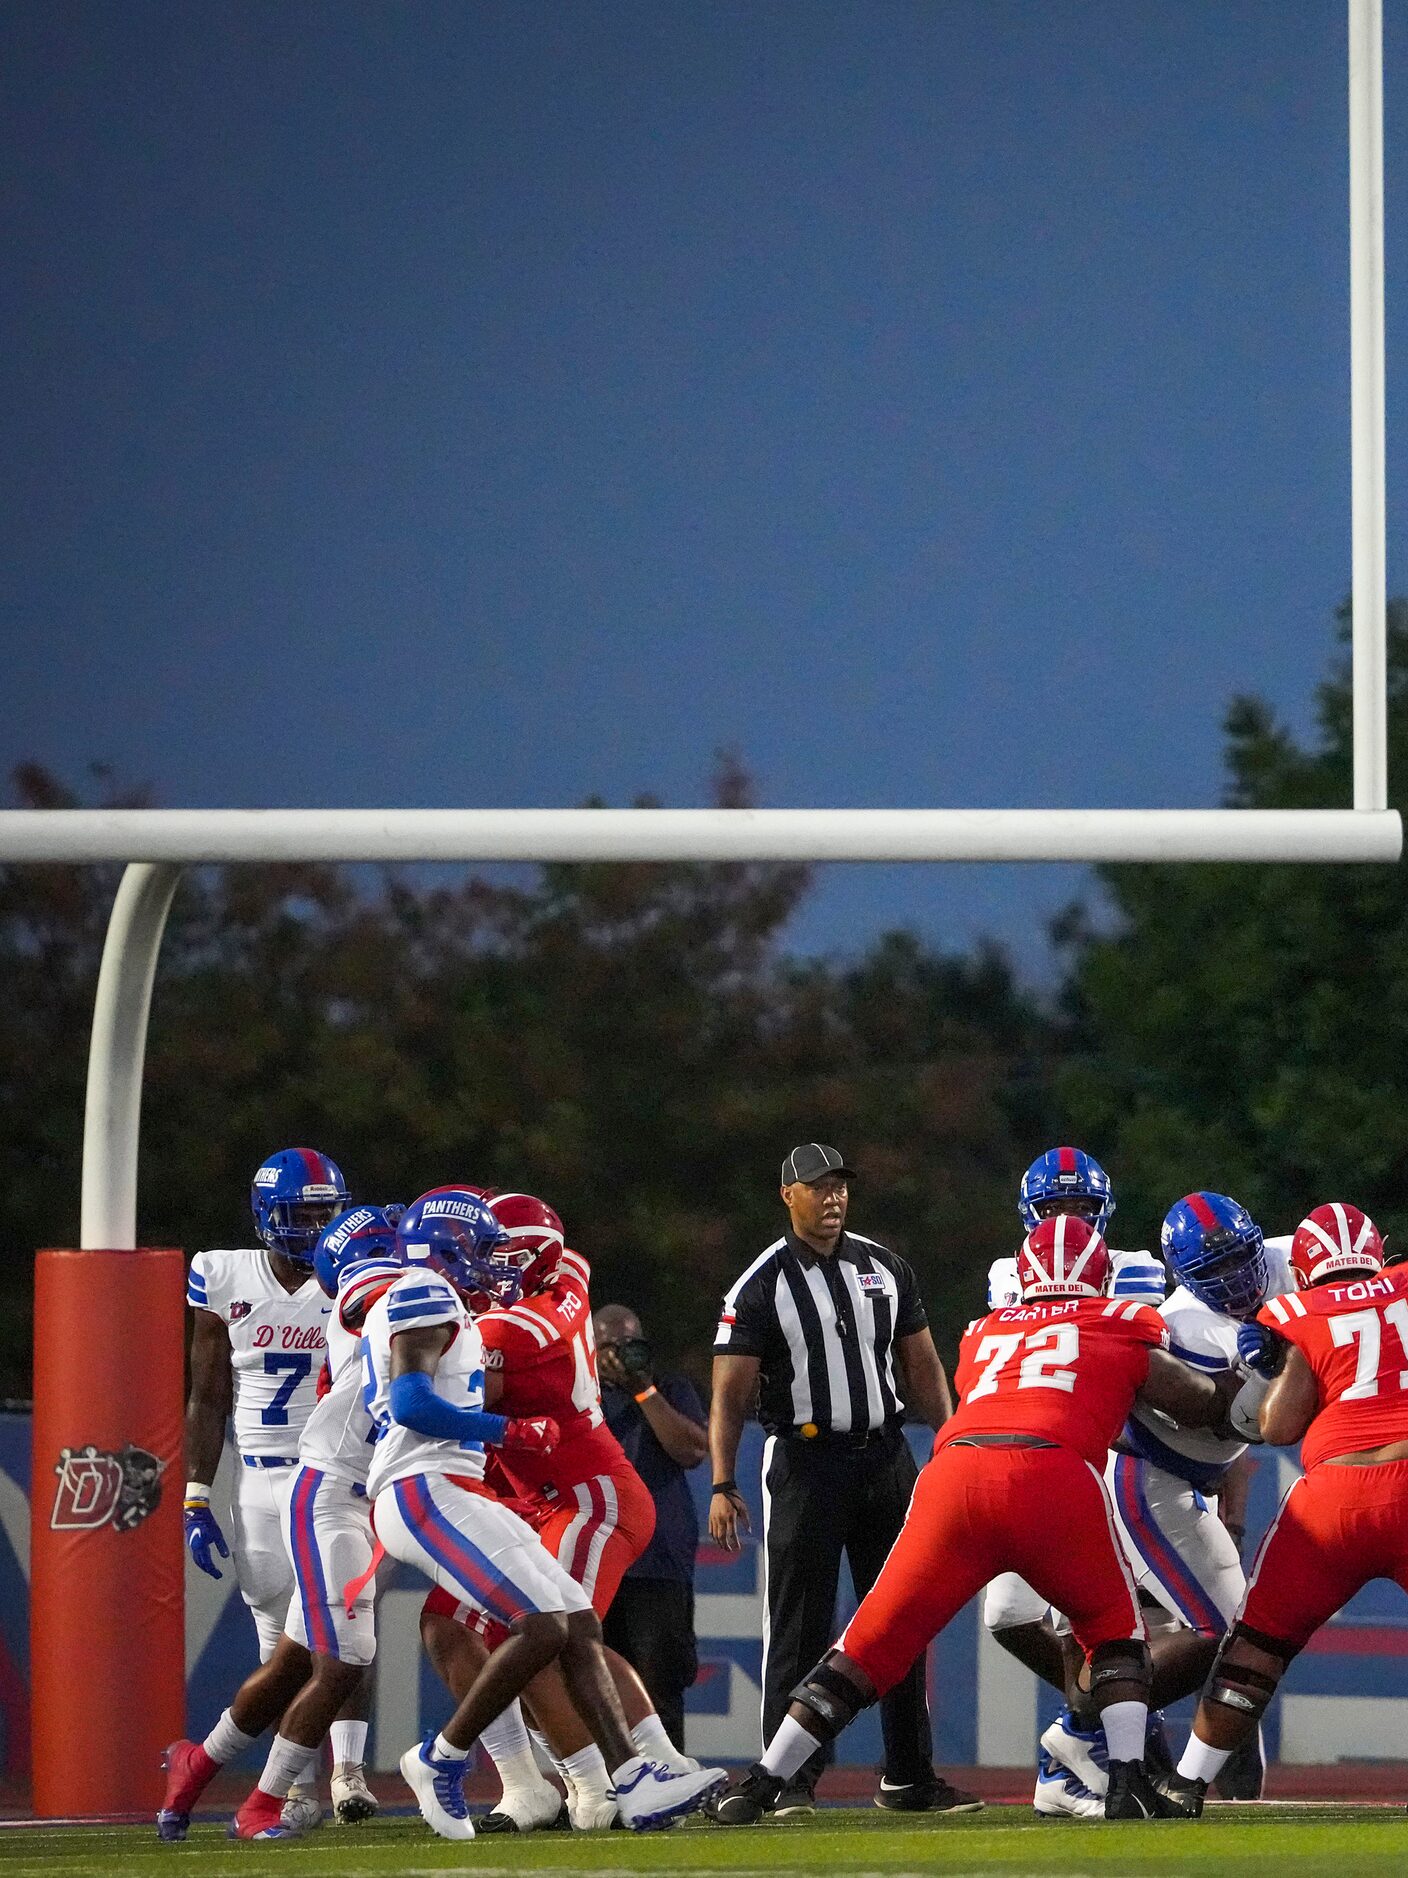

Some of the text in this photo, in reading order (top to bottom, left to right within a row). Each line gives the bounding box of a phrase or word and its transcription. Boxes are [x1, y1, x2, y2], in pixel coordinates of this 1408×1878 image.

[423, 1201, 481, 1220] PANTHERS
[327, 1209, 374, 1253] PANTHERS
[1326, 1256, 1373, 1270] MATER DEI
[1035, 1284, 1083, 1293] MATER DEI
[1328, 1277, 1395, 1301] TOHI
[556, 1290, 583, 1323] TEO
[253, 1324, 326, 1350] D'Ville
[966, 1322, 1080, 1405] 72
[261, 1352, 312, 1426] 7
